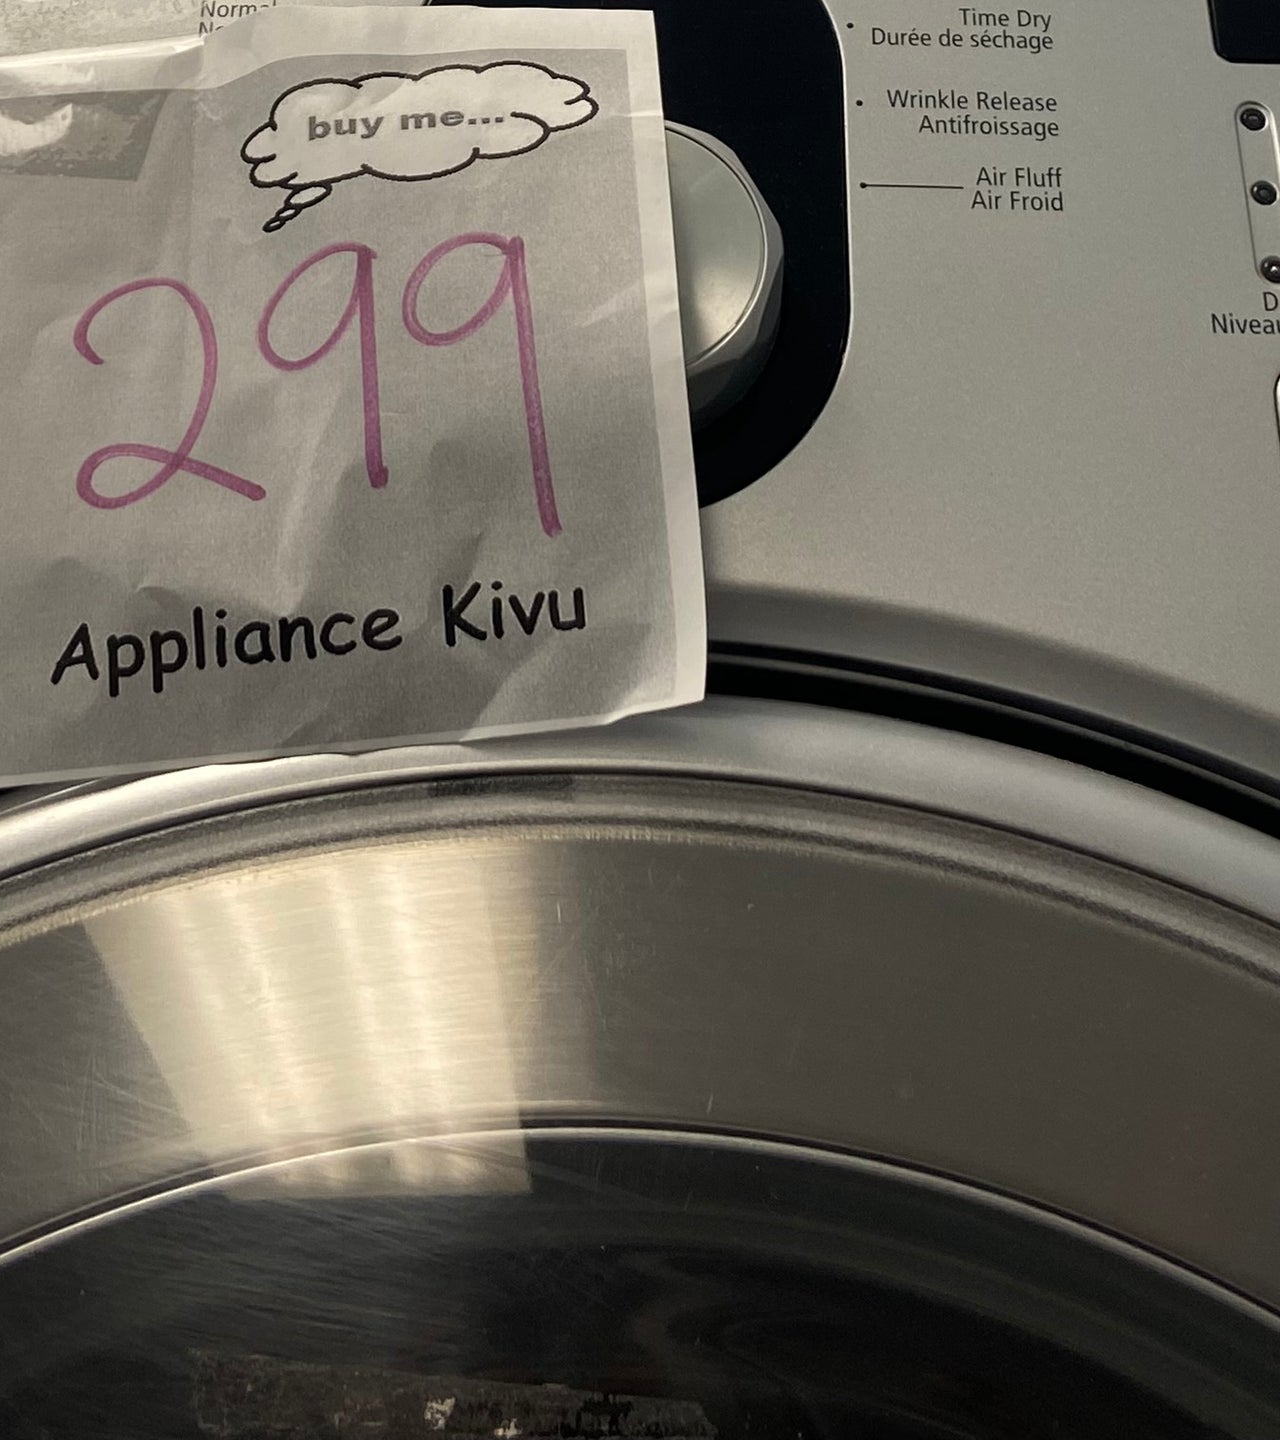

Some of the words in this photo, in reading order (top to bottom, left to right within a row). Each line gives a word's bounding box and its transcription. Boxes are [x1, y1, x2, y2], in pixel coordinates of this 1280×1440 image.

[201, 0, 276, 18] Norm
[959, 8, 1009, 26] Time
[1017, 10, 1051, 32] Dry
[872, 27, 932, 46] Durée
[938, 28, 963, 47] de
[970, 29, 1053, 54] séchage
[887, 89, 968, 109] Wrinkle
[976, 91, 1057, 111] Release
[307, 109, 383, 143] buy
[399, 107, 506, 130] me...
[919, 114, 1059, 141] Antifroissage
[976, 166, 1007, 186] Air
[1015, 167, 1063, 188] Fluff
[971, 190, 1002, 210] Air
[1010, 191, 1063, 212] Froid
[75, 229, 565, 542] 299
[51, 599, 405, 697] Appliance
[441, 577, 588, 652] Kivu
